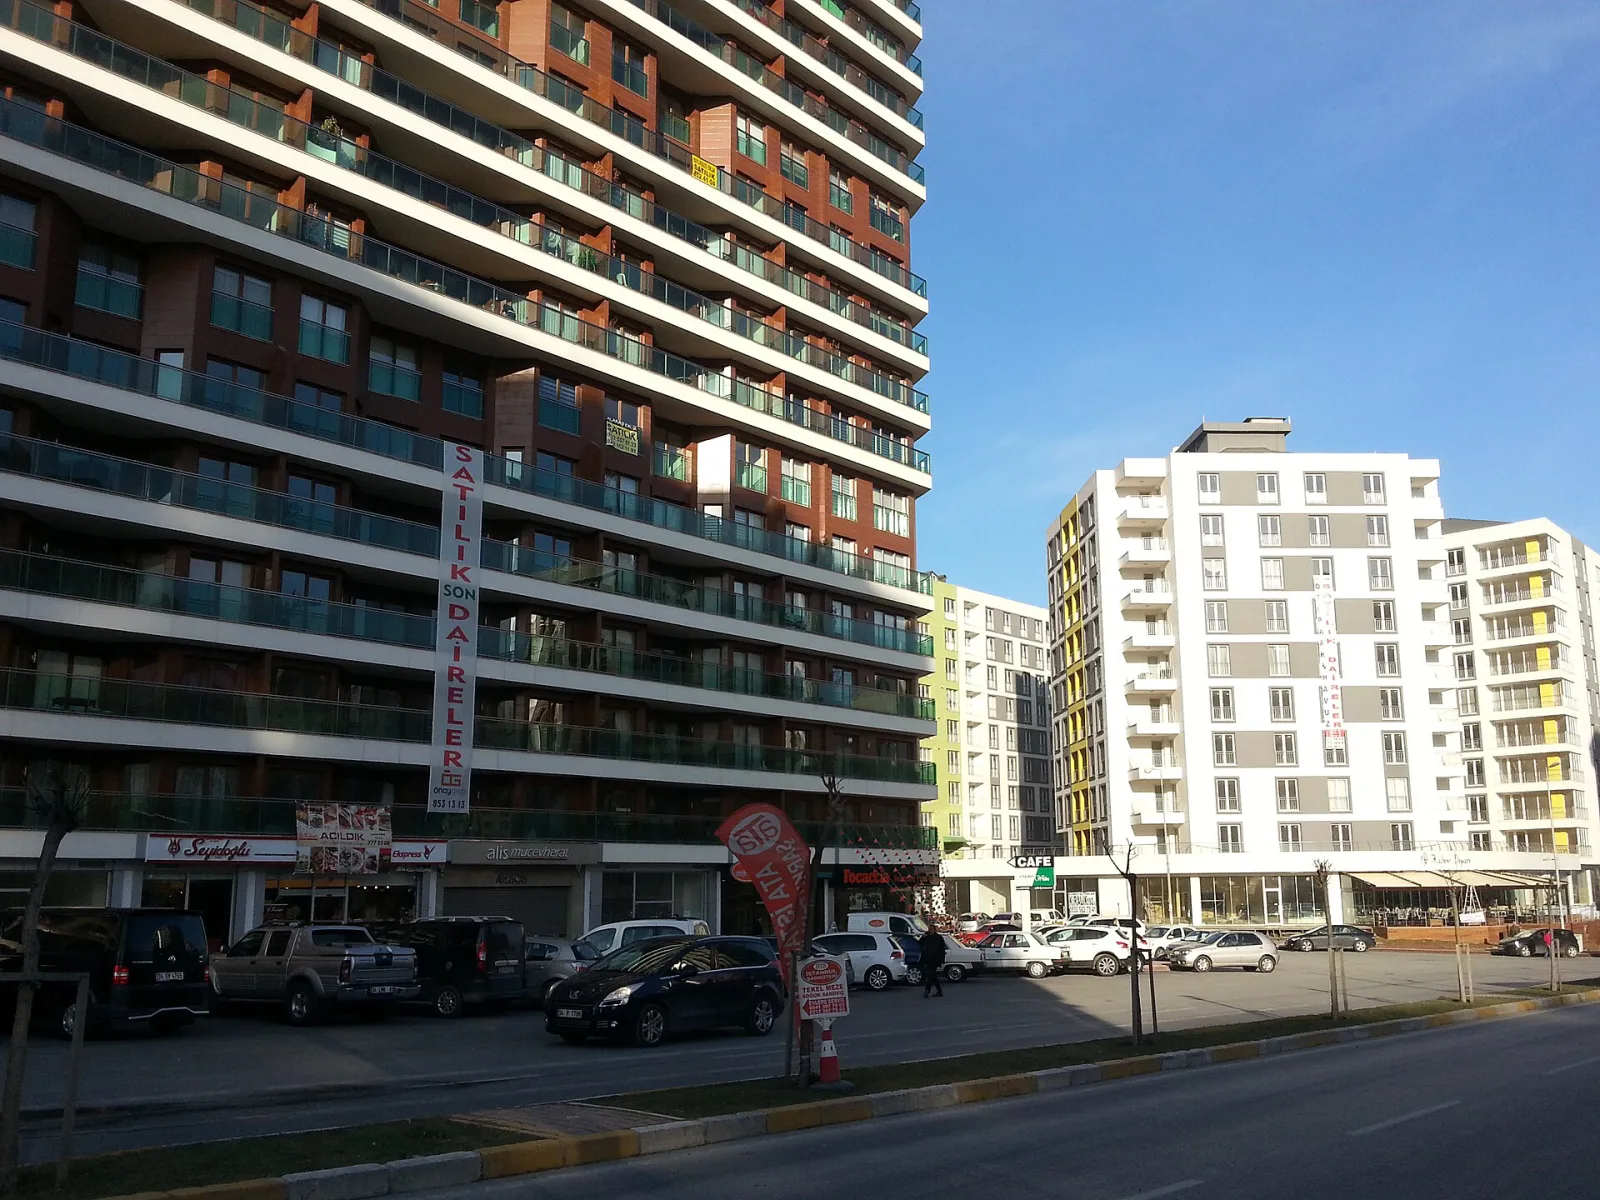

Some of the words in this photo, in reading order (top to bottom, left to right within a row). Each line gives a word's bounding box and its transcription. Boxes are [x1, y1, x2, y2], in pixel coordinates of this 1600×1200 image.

[452, 446, 476, 583] SATILIK
[444, 584, 476, 601] SON
[433, 800, 445, 808] 853
[448, 800, 456, 808] 13
[458, 800, 465, 809] 13
[184, 838, 251, 860] Seyidoğlu
[393, 850, 422, 859] Ekspress
[487, 846, 509, 860] alis
[511, 846, 569, 857] mucevherat
[1017, 856, 1051, 867] CAFE
